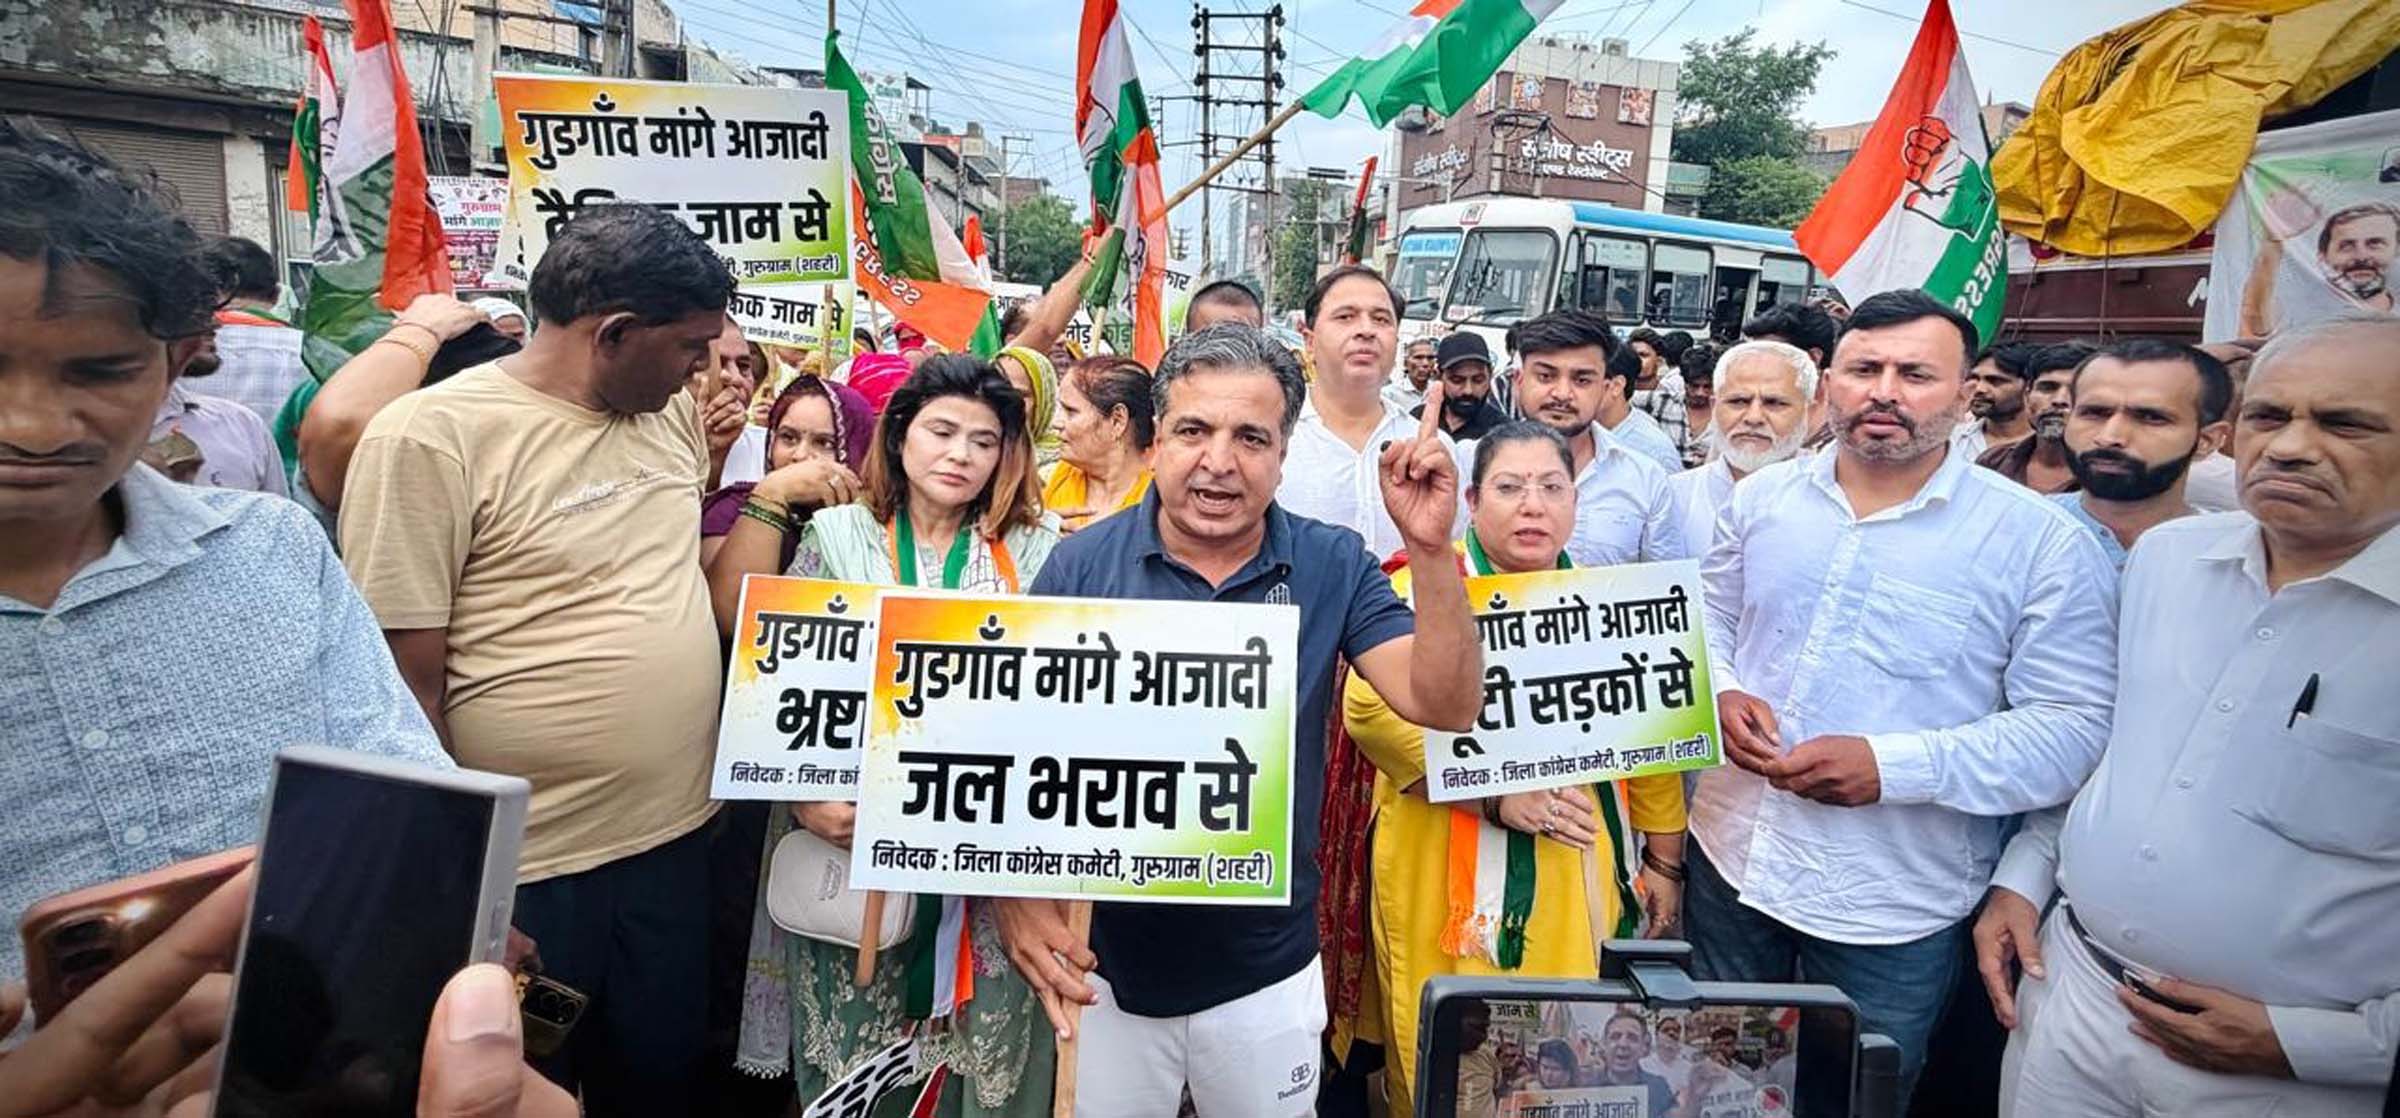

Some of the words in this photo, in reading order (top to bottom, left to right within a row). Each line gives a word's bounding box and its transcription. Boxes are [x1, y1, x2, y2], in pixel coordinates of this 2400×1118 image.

[518, 94, 637, 169] गुडगाँव
[644, 107, 716, 159] मांगे
[725, 110, 829, 160] आजादी
[687, 201, 782, 244] जाम
[790, 188, 832, 242] से
[769, 297, 818, 327] जाम
[756, 594, 865, 674] गुडगाँव
[1473, 593, 1527, 651] गाँव
[1531, 594, 1590, 646] मांगे
[1598, 585, 1689, 639] आजादी
[894, 613, 1027, 718] गुडगाँव
[1034, 631, 1121, 706] मांगे
[1132, 636, 1271, 711] आजादी
[1523, 650, 1649, 733] सड़कों
[1652, 647, 1695, 709] से
[776, 687, 865, 751] भ्रष्टा
[730, 762, 785, 786] निवेदक
[797, 764, 836, 787] जिला
[897, 749, 1015, 825] जल
[1027, 753, 1184, 832] भराव
[1195, 737, 1257, 833] से
[1442, 768, 1491, 790] निवेदक
[1502, 762, 1536, 783] जिला
[1537, 754, 1577, 779] कांग्रेस
[1579, 747, 1620, 772] कमेटी,
[1621, 746, 1666, 772] गुरुग्राम
[1669, 734, 1712, 761] (शहरी)
[872, 840, 938, 871] निवेदक
[953, 844, 1003, 874] जिला
[1006, 843, 1063, 877] कांग्रेस
[1066, 847, 1126, 882] कमेटी,
[1130, 856, 1201, 887] गुरुग्राम
[1205, 850, 1272, 887] (शहरी)
